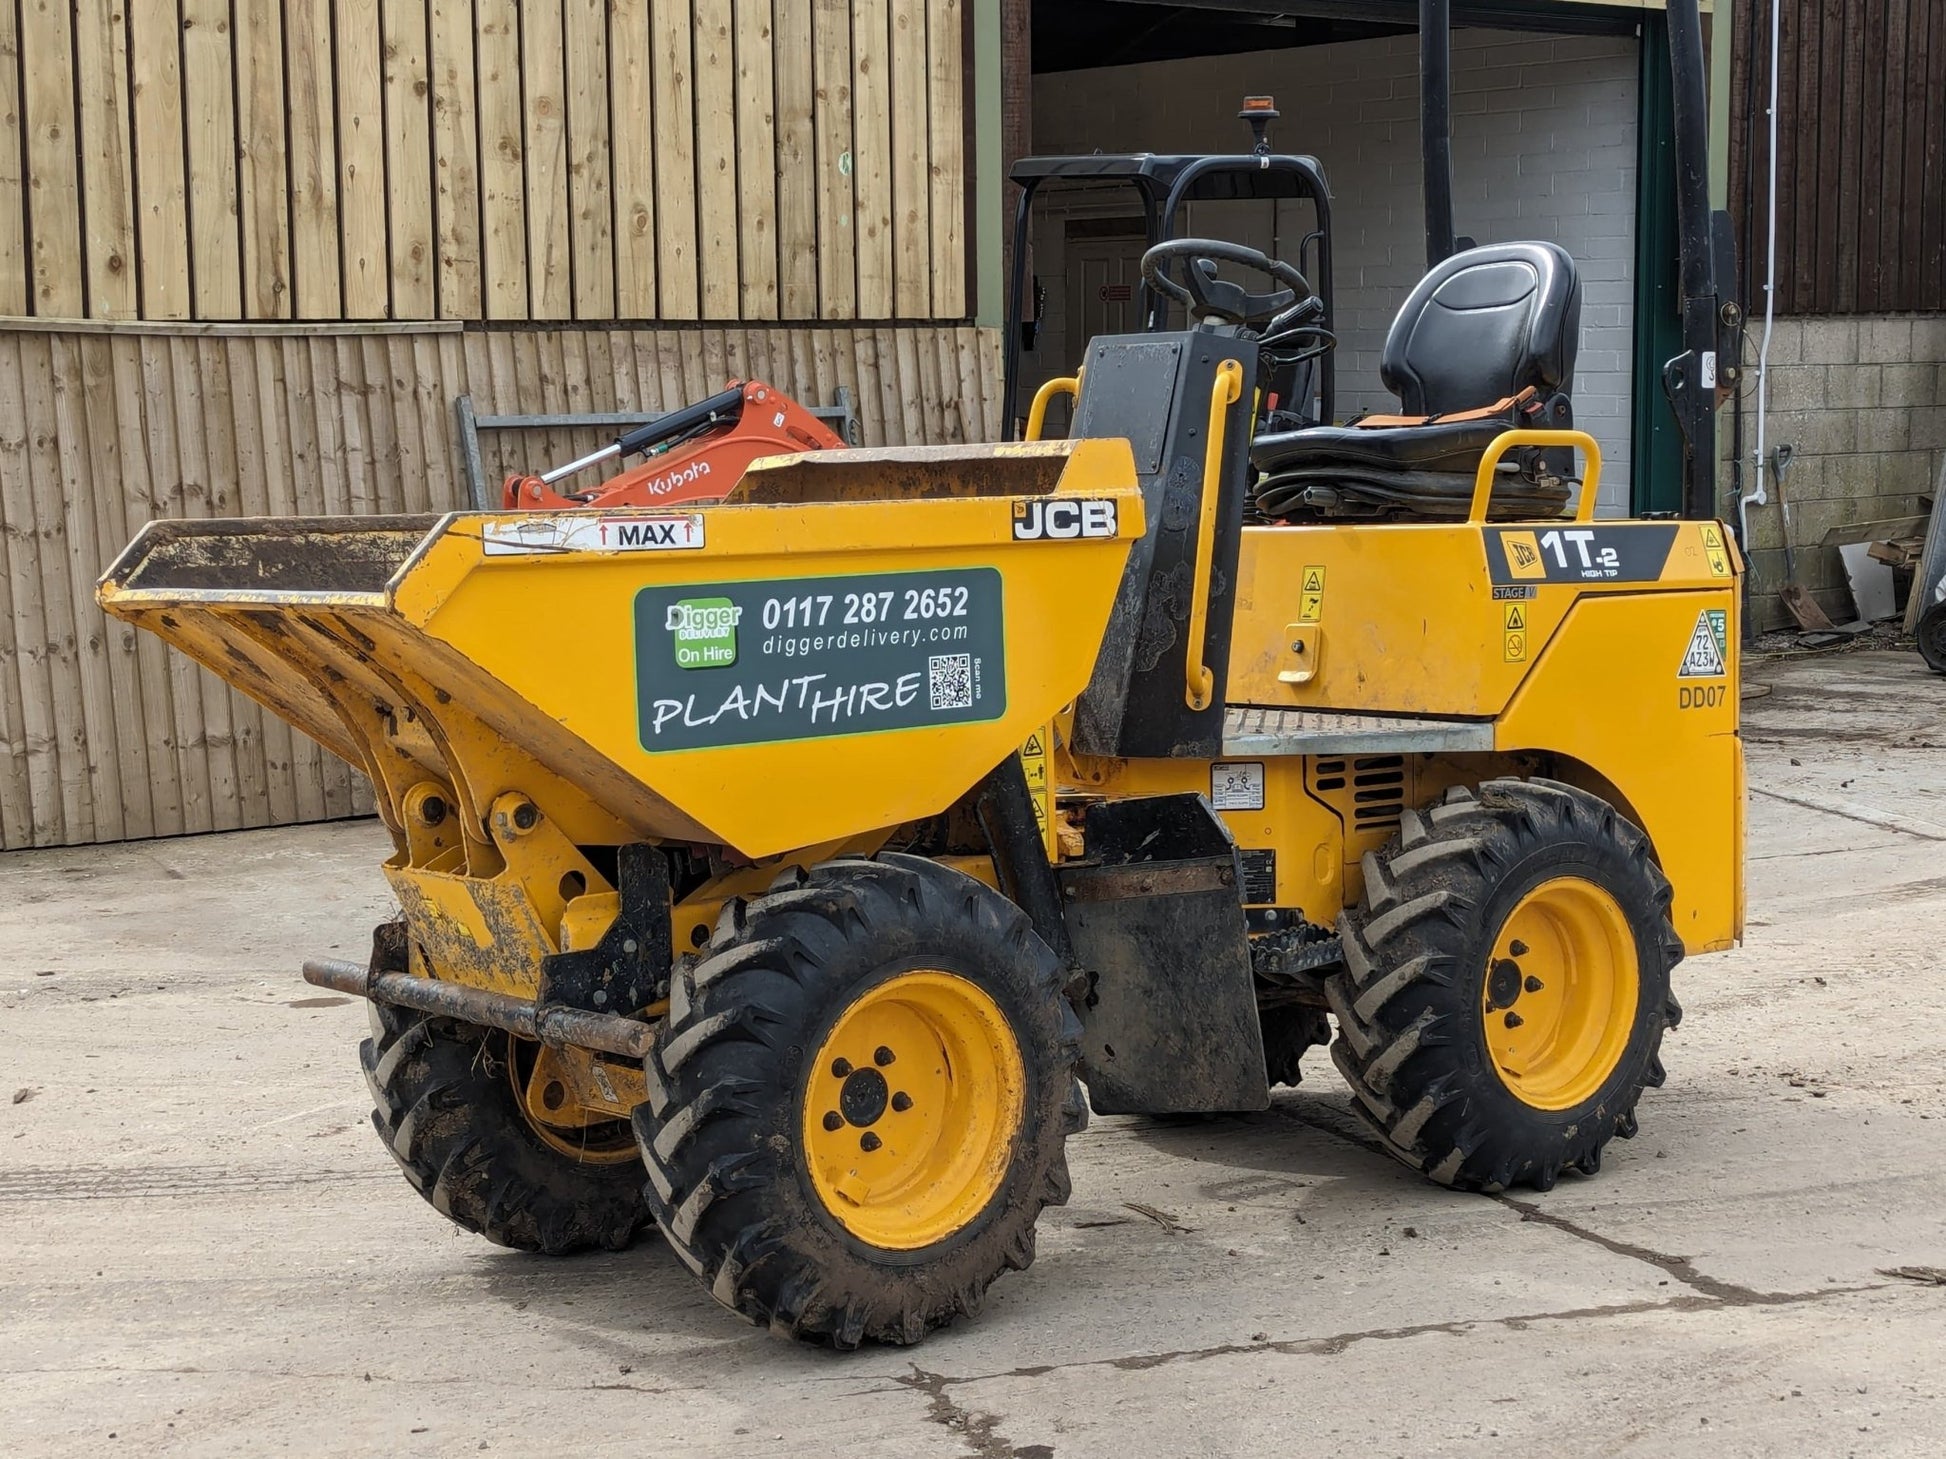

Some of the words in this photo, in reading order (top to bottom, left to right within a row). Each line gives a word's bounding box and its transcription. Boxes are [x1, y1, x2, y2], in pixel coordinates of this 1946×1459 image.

[648, 461, 711, 496] Kubota
[1014, 500, 1117, 540] JCB
[618, 523, 677, 546] MAX
[1512, 543, 1537, 566] JCB
[1581, 569, 1603, 578] HIGH
[1605, 569, 1619, 577] TIP
[1493, 587, 1524, 599] STAGE
[665, 604, 743, 631] Digger
[762, 595, 834, 630] 0117
[843, 591, 895, 625] 287
[903, 586, 969, 620] 2652
[763, 625, 968, 657] diggerdelivery.com
[1696, 634, 1709, 650] 72
[678, 648, 700, 663] On
[703, 646, 733, 662] Hire
[974, 657, 982, 682] Scan
[1679, 685, 1726, 710] DD07
